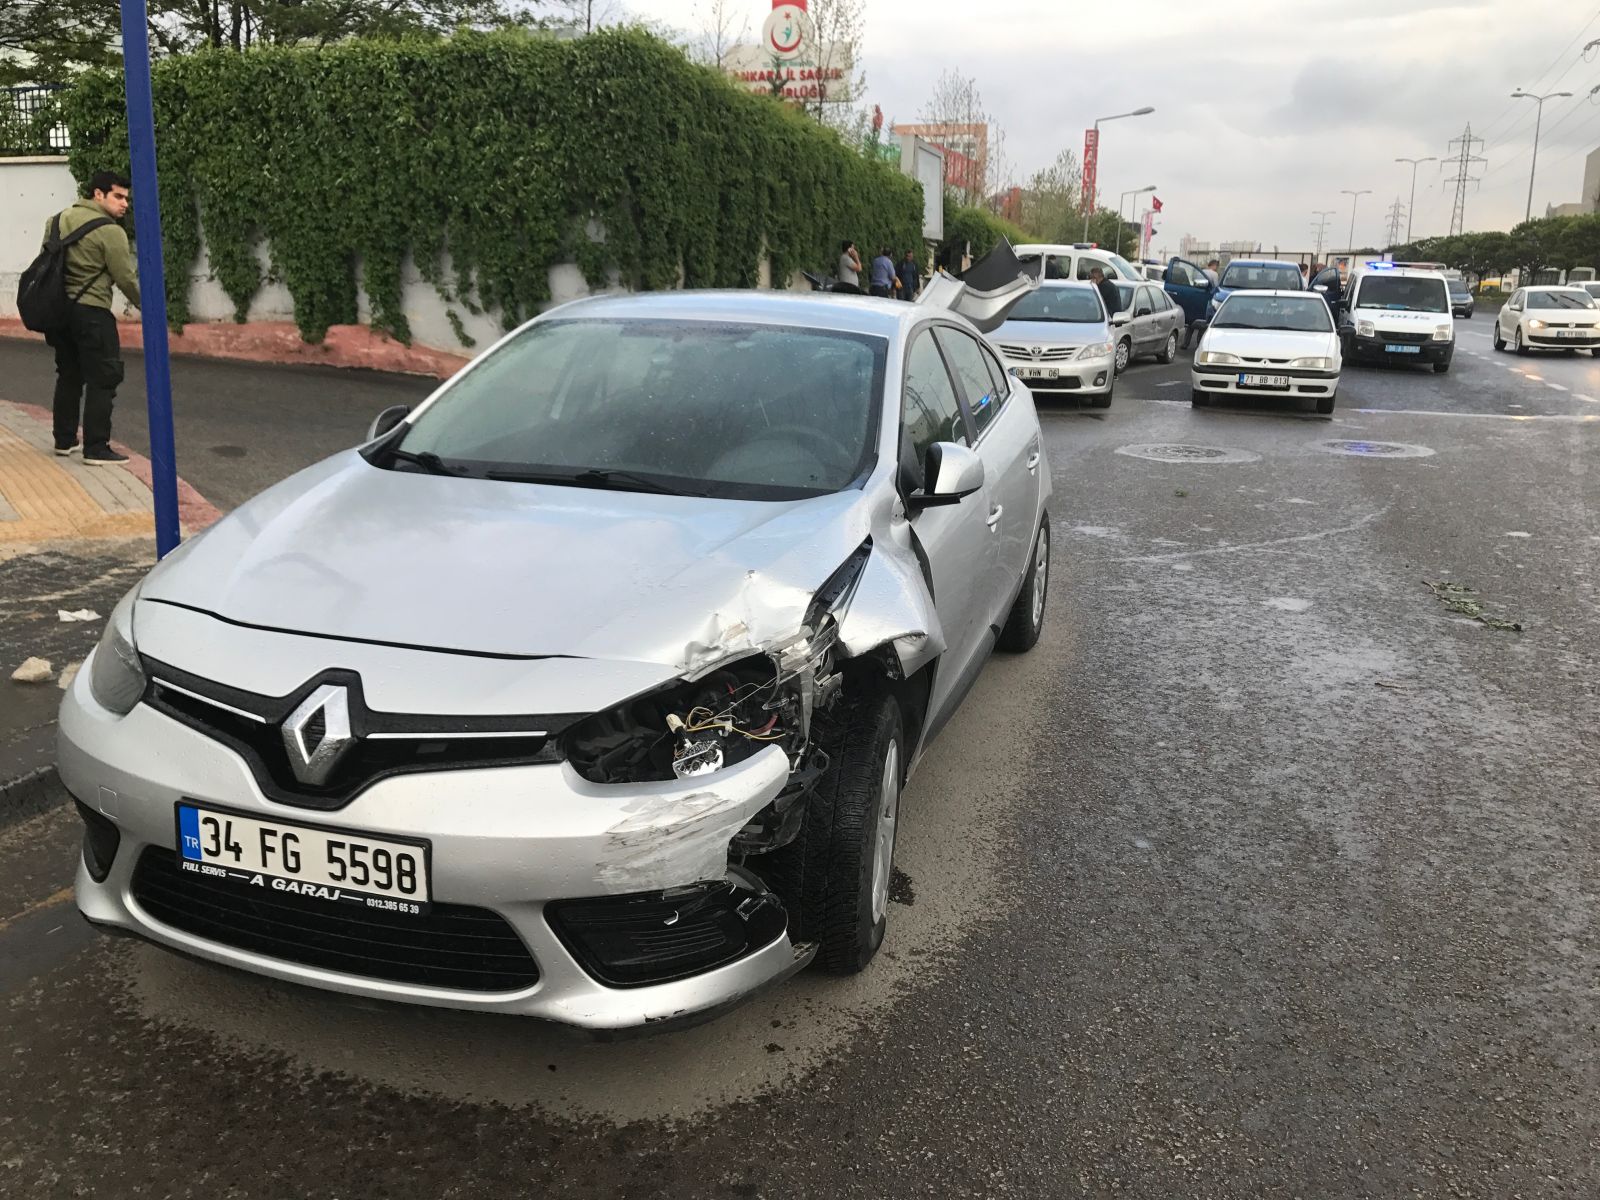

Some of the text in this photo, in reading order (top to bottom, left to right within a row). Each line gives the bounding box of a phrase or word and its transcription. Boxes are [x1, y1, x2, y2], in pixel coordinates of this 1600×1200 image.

[184, 835, 199, 849] TR
[202, 816, 417, 895] 34 FG 5598
[182, 861, 200, 873] FULL
[249, 874, 265, 887] A
[271, 878, 341, 901] GARAJ
[366, 897, 398, 911] 0312.385
[399, 902, 409, 913] 65
[409, 904, 420, 915] 39
